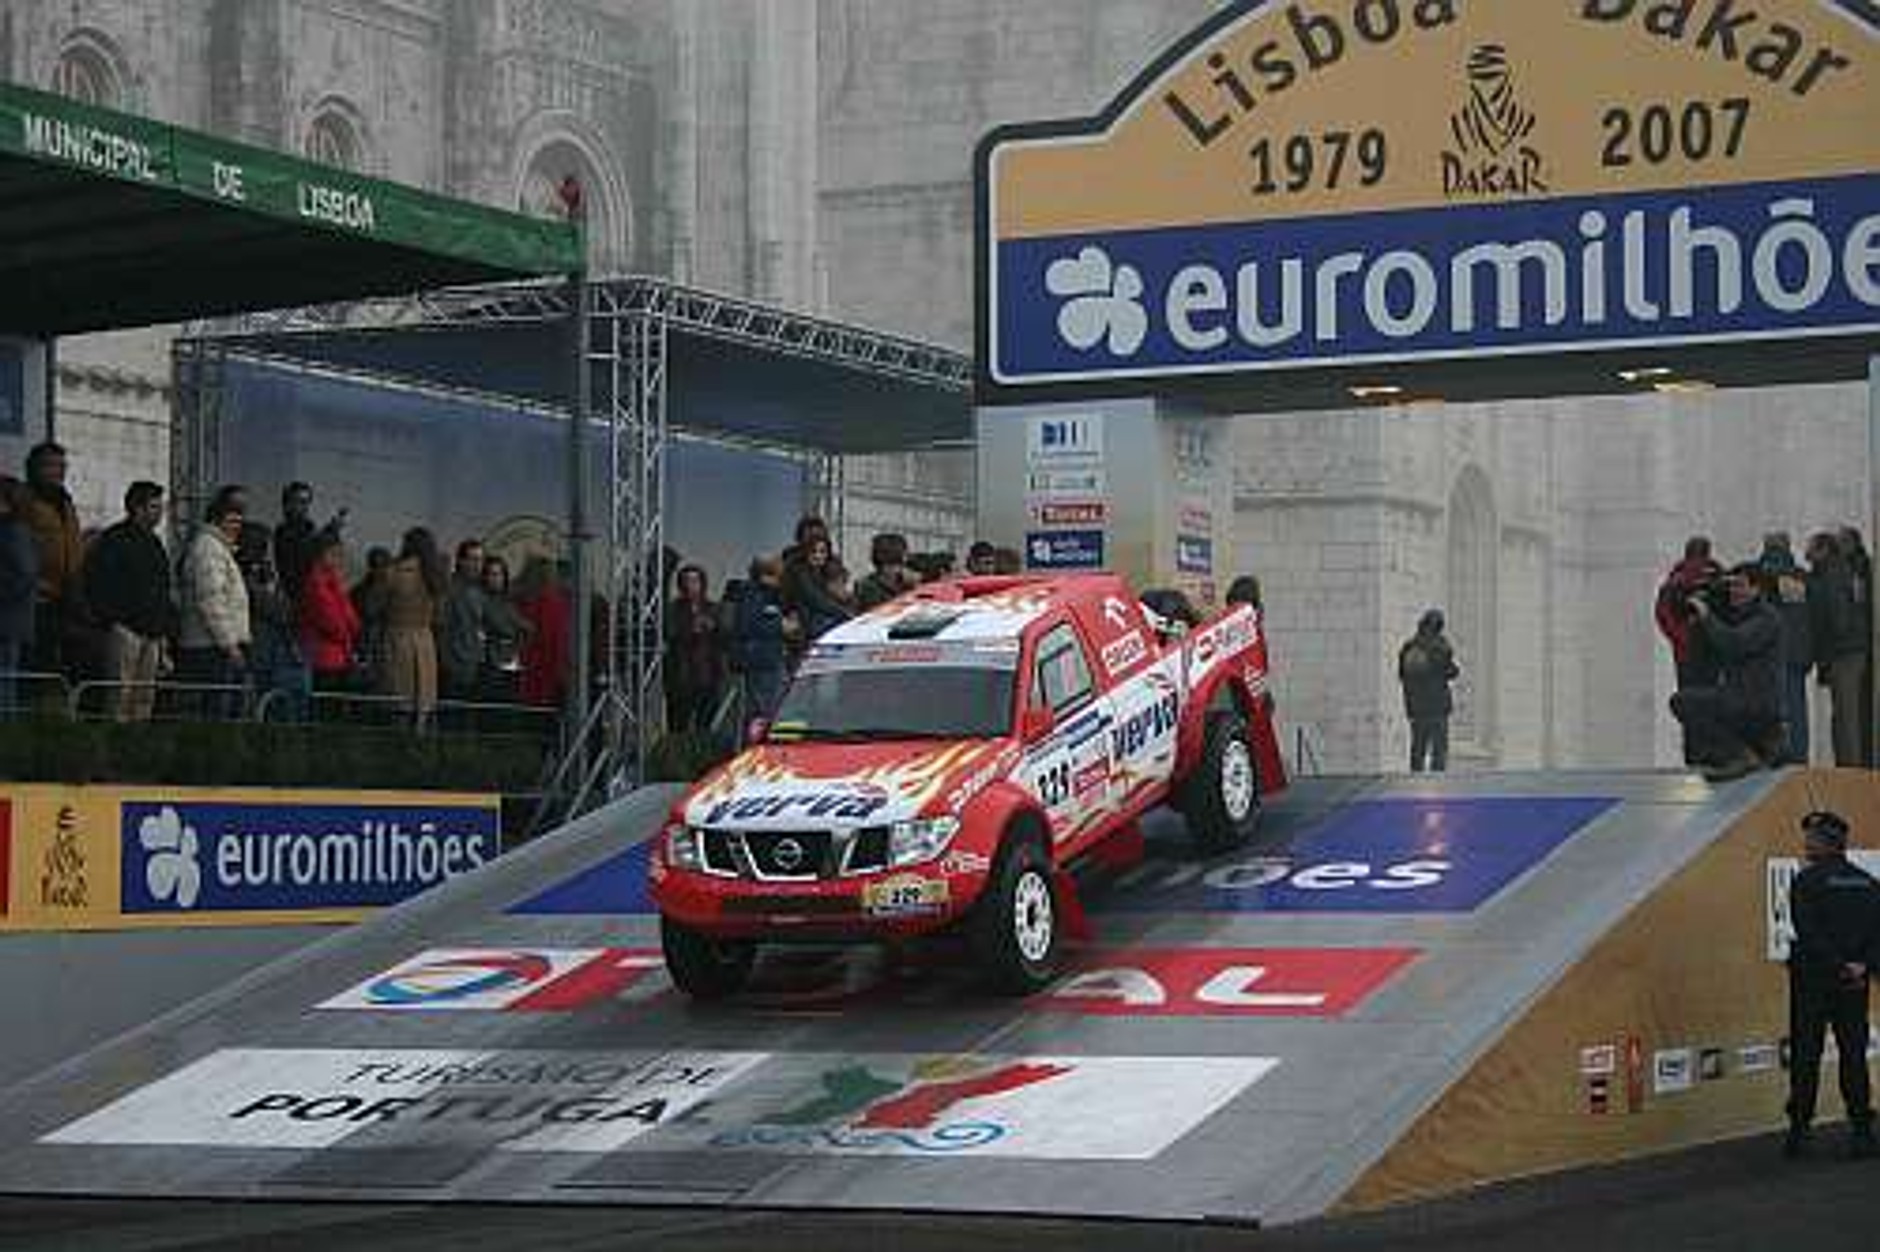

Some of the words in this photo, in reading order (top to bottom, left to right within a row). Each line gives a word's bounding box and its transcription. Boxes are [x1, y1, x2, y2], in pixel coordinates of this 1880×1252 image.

[1163, 0, 1458, 147] Lisboa
[1249, 128, 1386, 194] 1979
[1600, 98, 1750, 167] 2007
[23, 112, 156, 182] MUNICIPAL
[212, 161, 246, 201] DE
[298, 181, 375, 233] LISBOA
[216, 819, 485, 885] euromilhões
